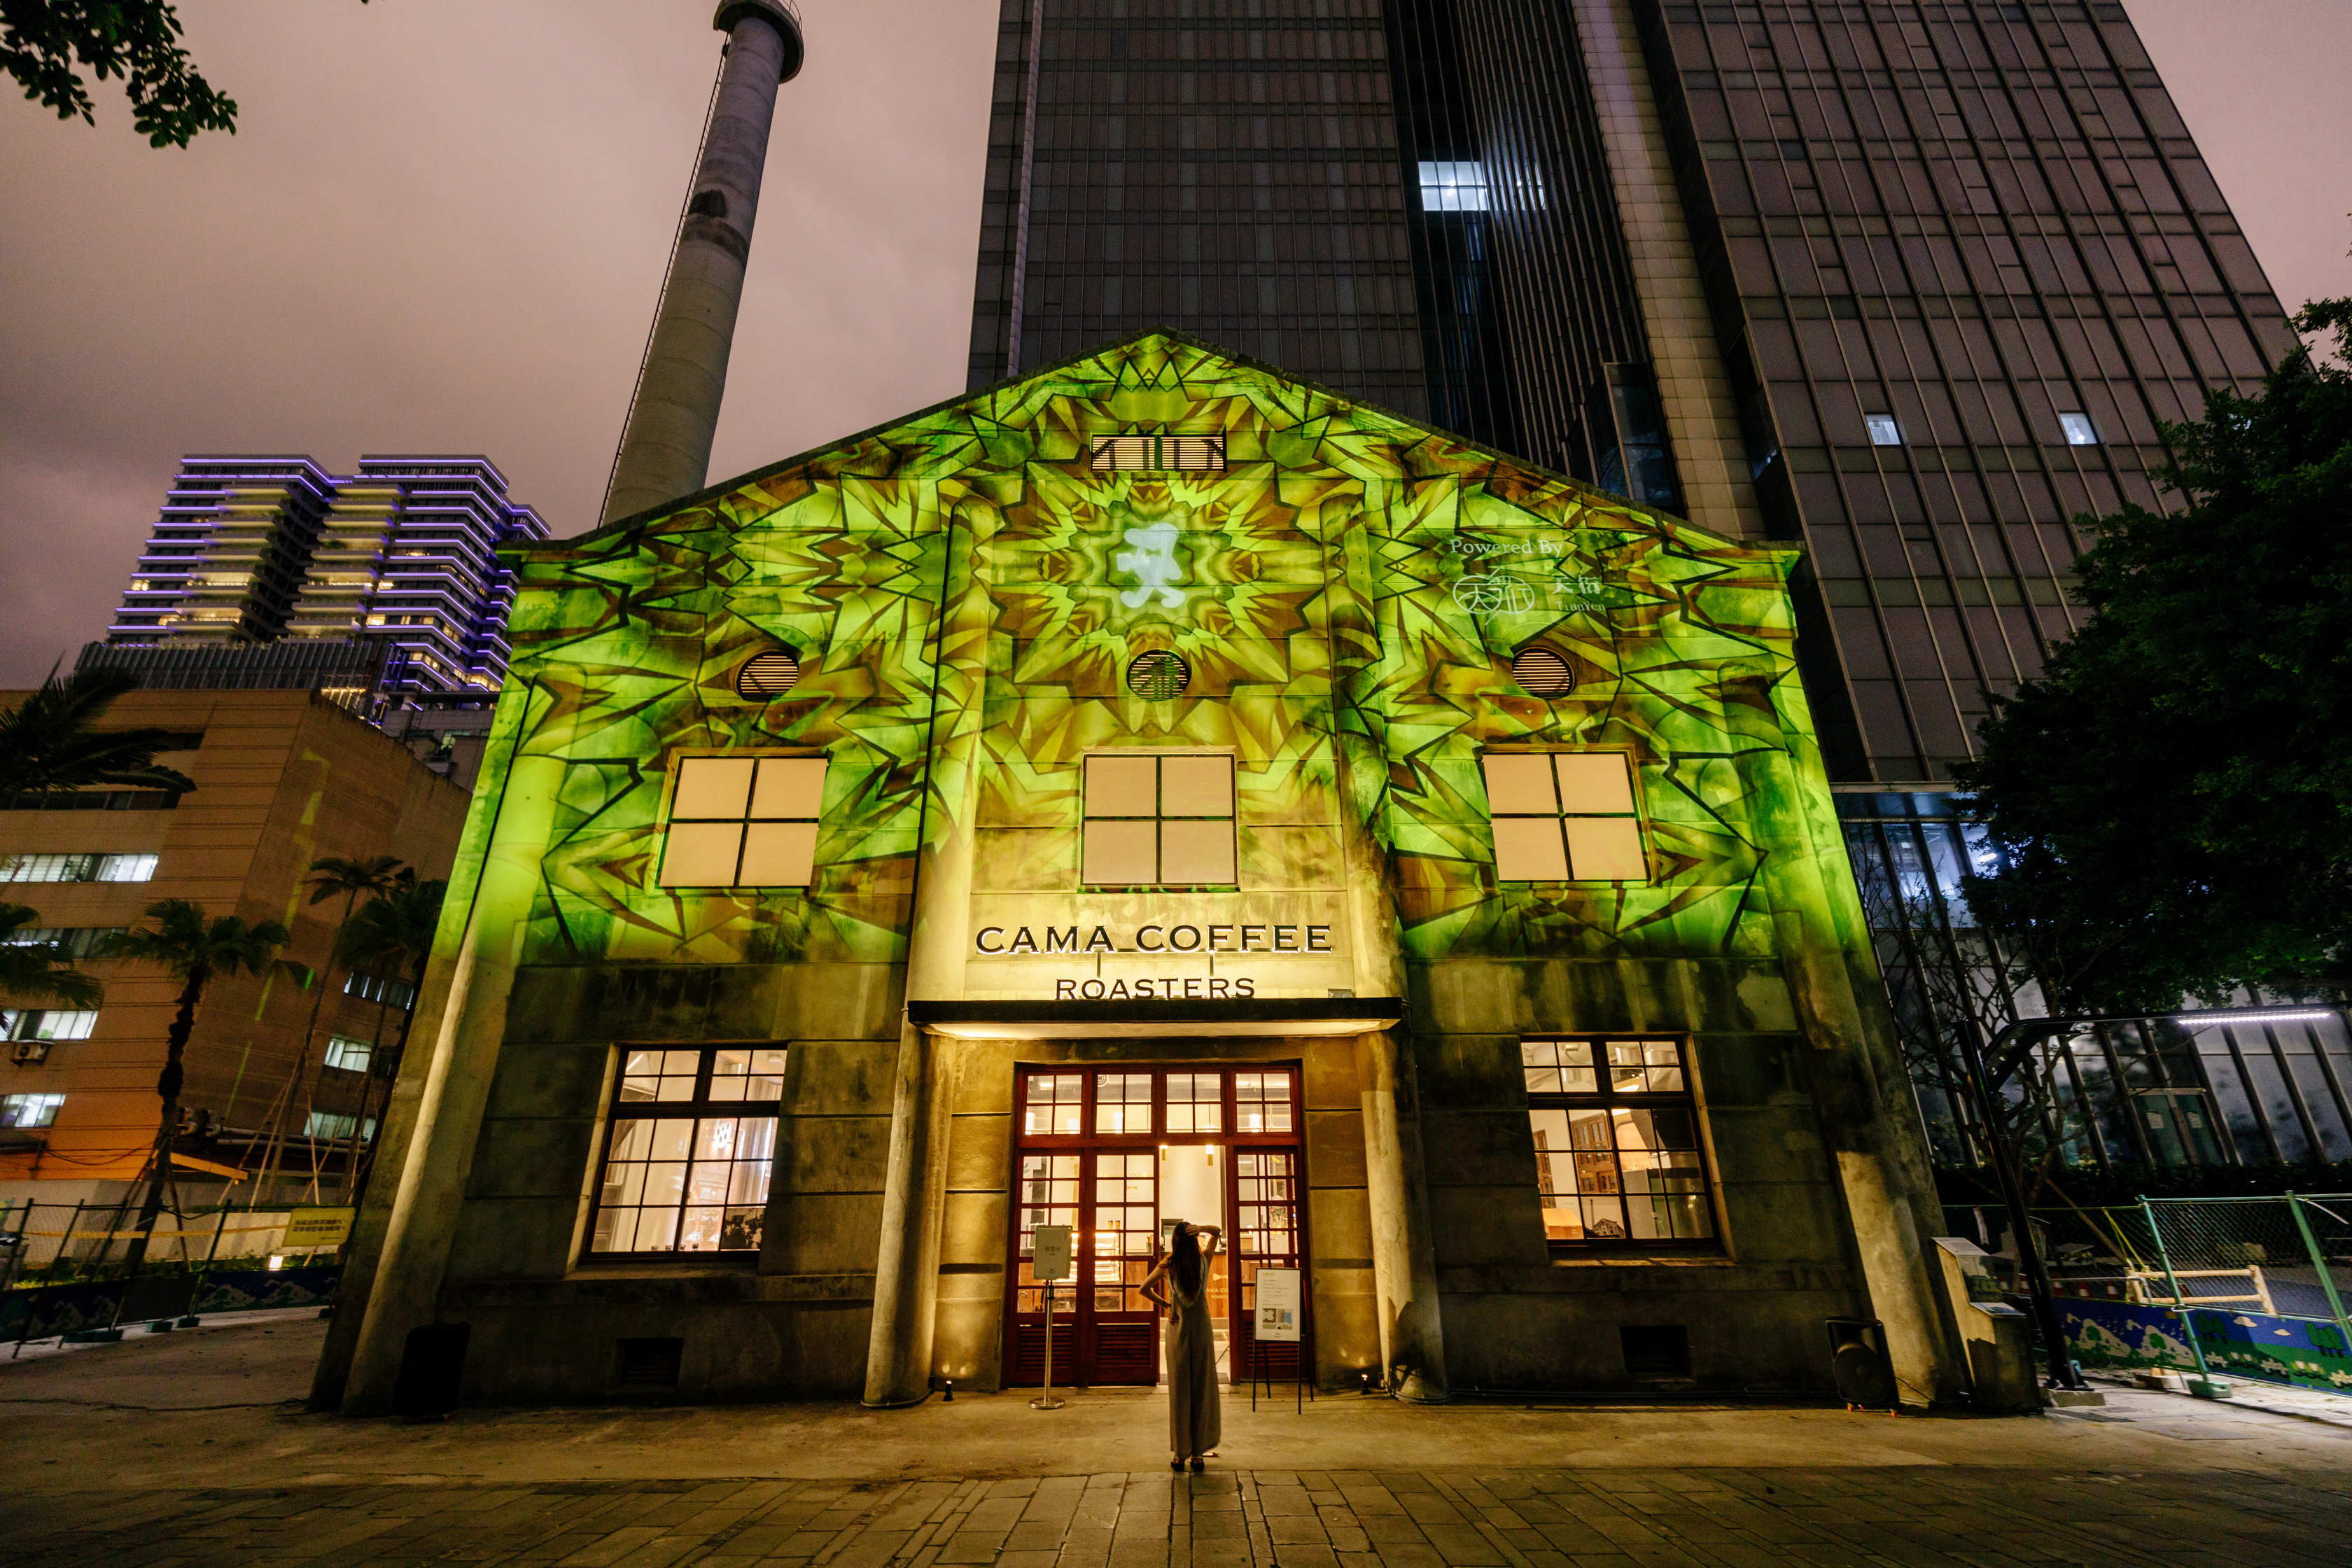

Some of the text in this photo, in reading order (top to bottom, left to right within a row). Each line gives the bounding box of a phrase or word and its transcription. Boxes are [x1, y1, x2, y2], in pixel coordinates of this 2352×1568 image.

[1450, 539, 1563, 558] Powered By
[1555, 601, 1606, 611] TianYen
[976, 924, 1332, 953] CAMA COFFEE
[1055, 978, 1254, 1000] ROASTERS
